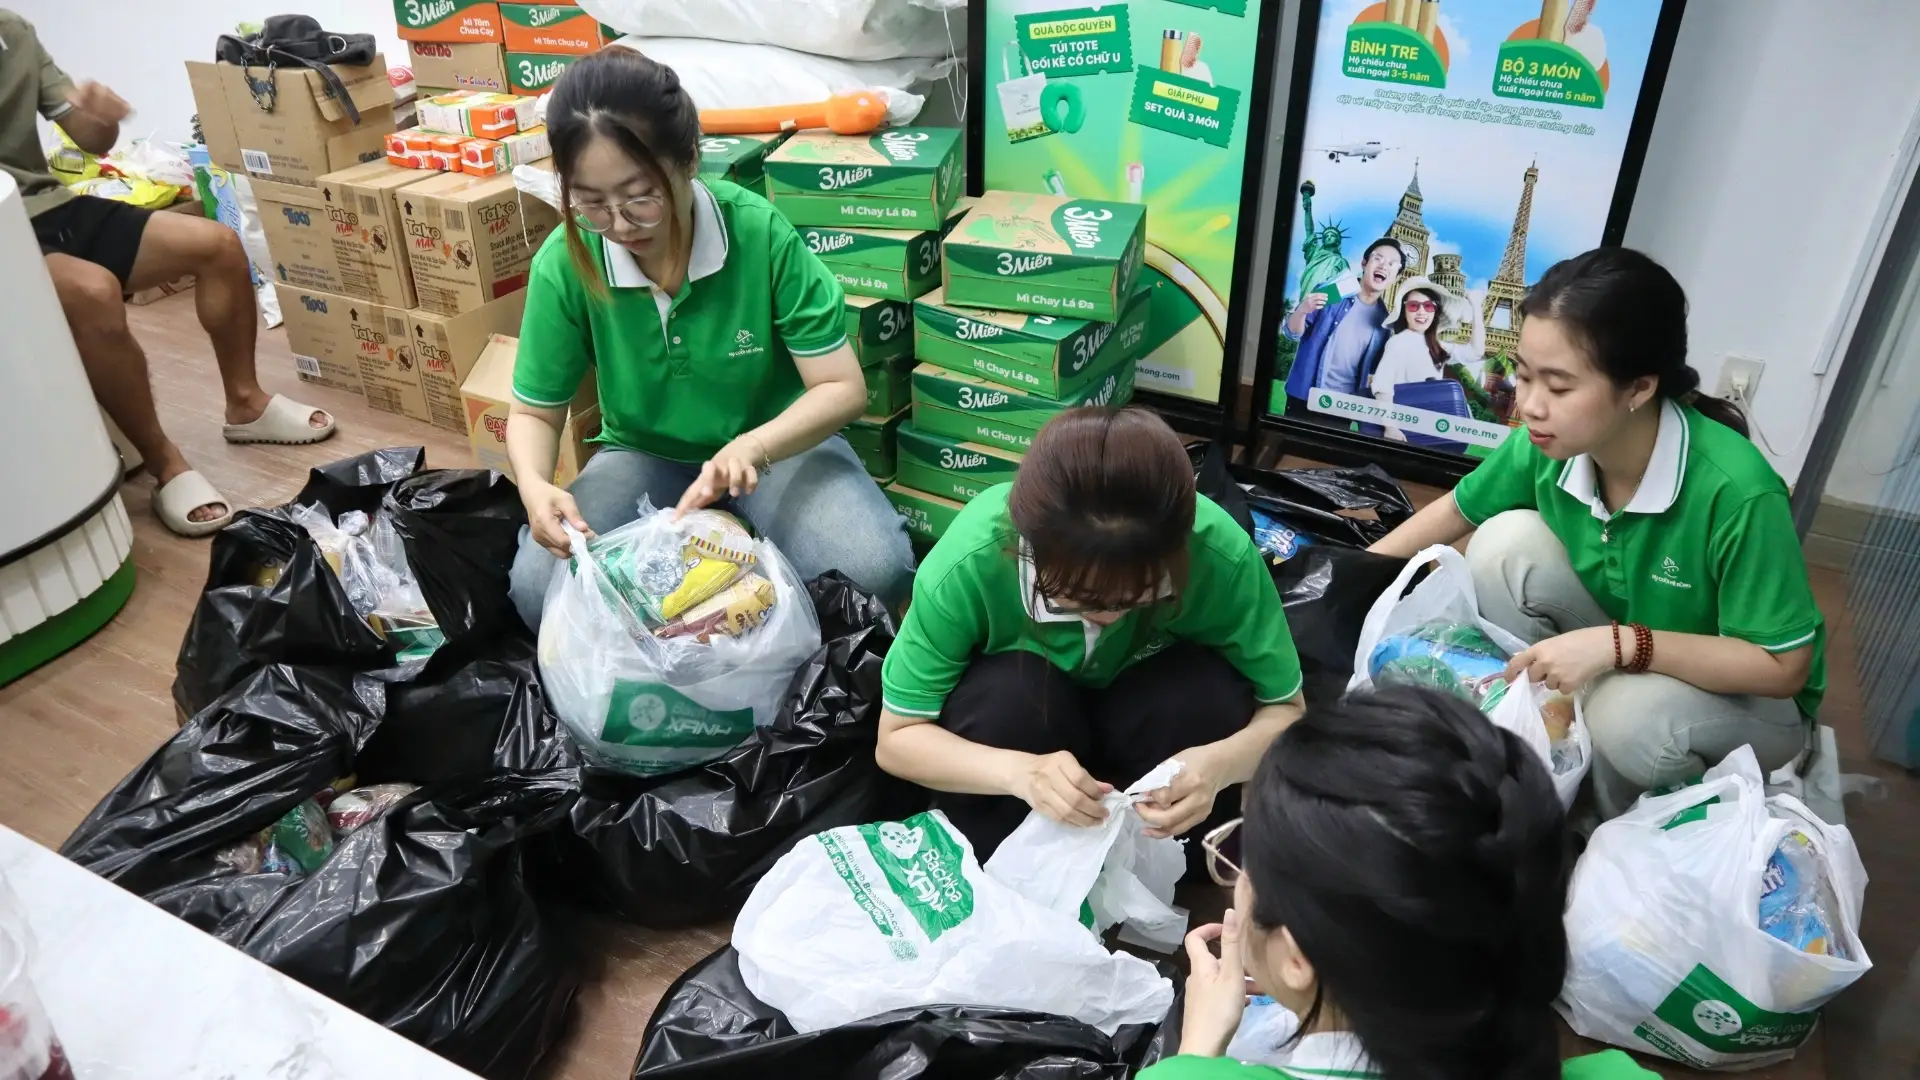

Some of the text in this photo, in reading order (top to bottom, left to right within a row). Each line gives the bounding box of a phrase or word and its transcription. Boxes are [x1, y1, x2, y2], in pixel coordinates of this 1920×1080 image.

[463, 18, 490, 27] Mì Tôm
[1033, 25, 1054, 36] QUÀ
[1055, 22, 1077, 34] ĐỘC
[460, 27, 495, 37] Chua Cay
[534, 37, 589, 48] Mì Tôm Chua Cay
[1050, 40, 1098, 54] TÚI TOTE
[1350, 37, 1419, 60] BÌNH TRE
[1052, 54, 1066, 68] KÊ
[1085, 51, 1111, 65] CHỮ
[1112, 52, 1121, 63] U
[1348, 56, 1407, 70] Hộ chiếu chưa
[1367, 68, 1390, 78] ngoại
[1391, 69, 1408, 79] 3-5
[1410, 72, 1430, 82] năm
[1502, 57, 1581, 80] BỘ 3 MÓN
[1499, 74, 1563, 89] Hộ chiếu chưa
[1167, 87, 1204, 105] GIẢI PHỤ
[1519, 87, 1544, 98] ngoại
[1545, 89, 1564, 99] trên
[1565, 91, 1572, 100] 5
[1573, 92, 1596, 103] năm
[1144, 101, 1220, 130] SET QUÀ 3 MÓN
[325, 204, 358, 225] Tako
[478, 201, 516, 224] Tako
[841, 205, 917, 218] Mì Chay Lá Đa
[336, 223, 354, 234] MAX
[406, 219, 441, 240] Tako
[415, 238, 436, 248] MAX
[834, 274, 888, 289] Chay Lá Đa
[1016, 293, 1094, 309] Mì Chay Lá Đa
[351, 324, 385, 344] Tako
[361, 342, 380, 352] MAX
[417, 340, 450, 363] Tako
[426, 359, 446, 370] MAX
[974, 359, 1039, 385] Mì Chay Lá Đa
[1336, 400, 1420, 424] 0292.777.3399
[977, 426, 1031, 445] Mì Chay Lá
[1454, 423, 1498, 440] vere.me
[953, 485, 965, 495] Mì
